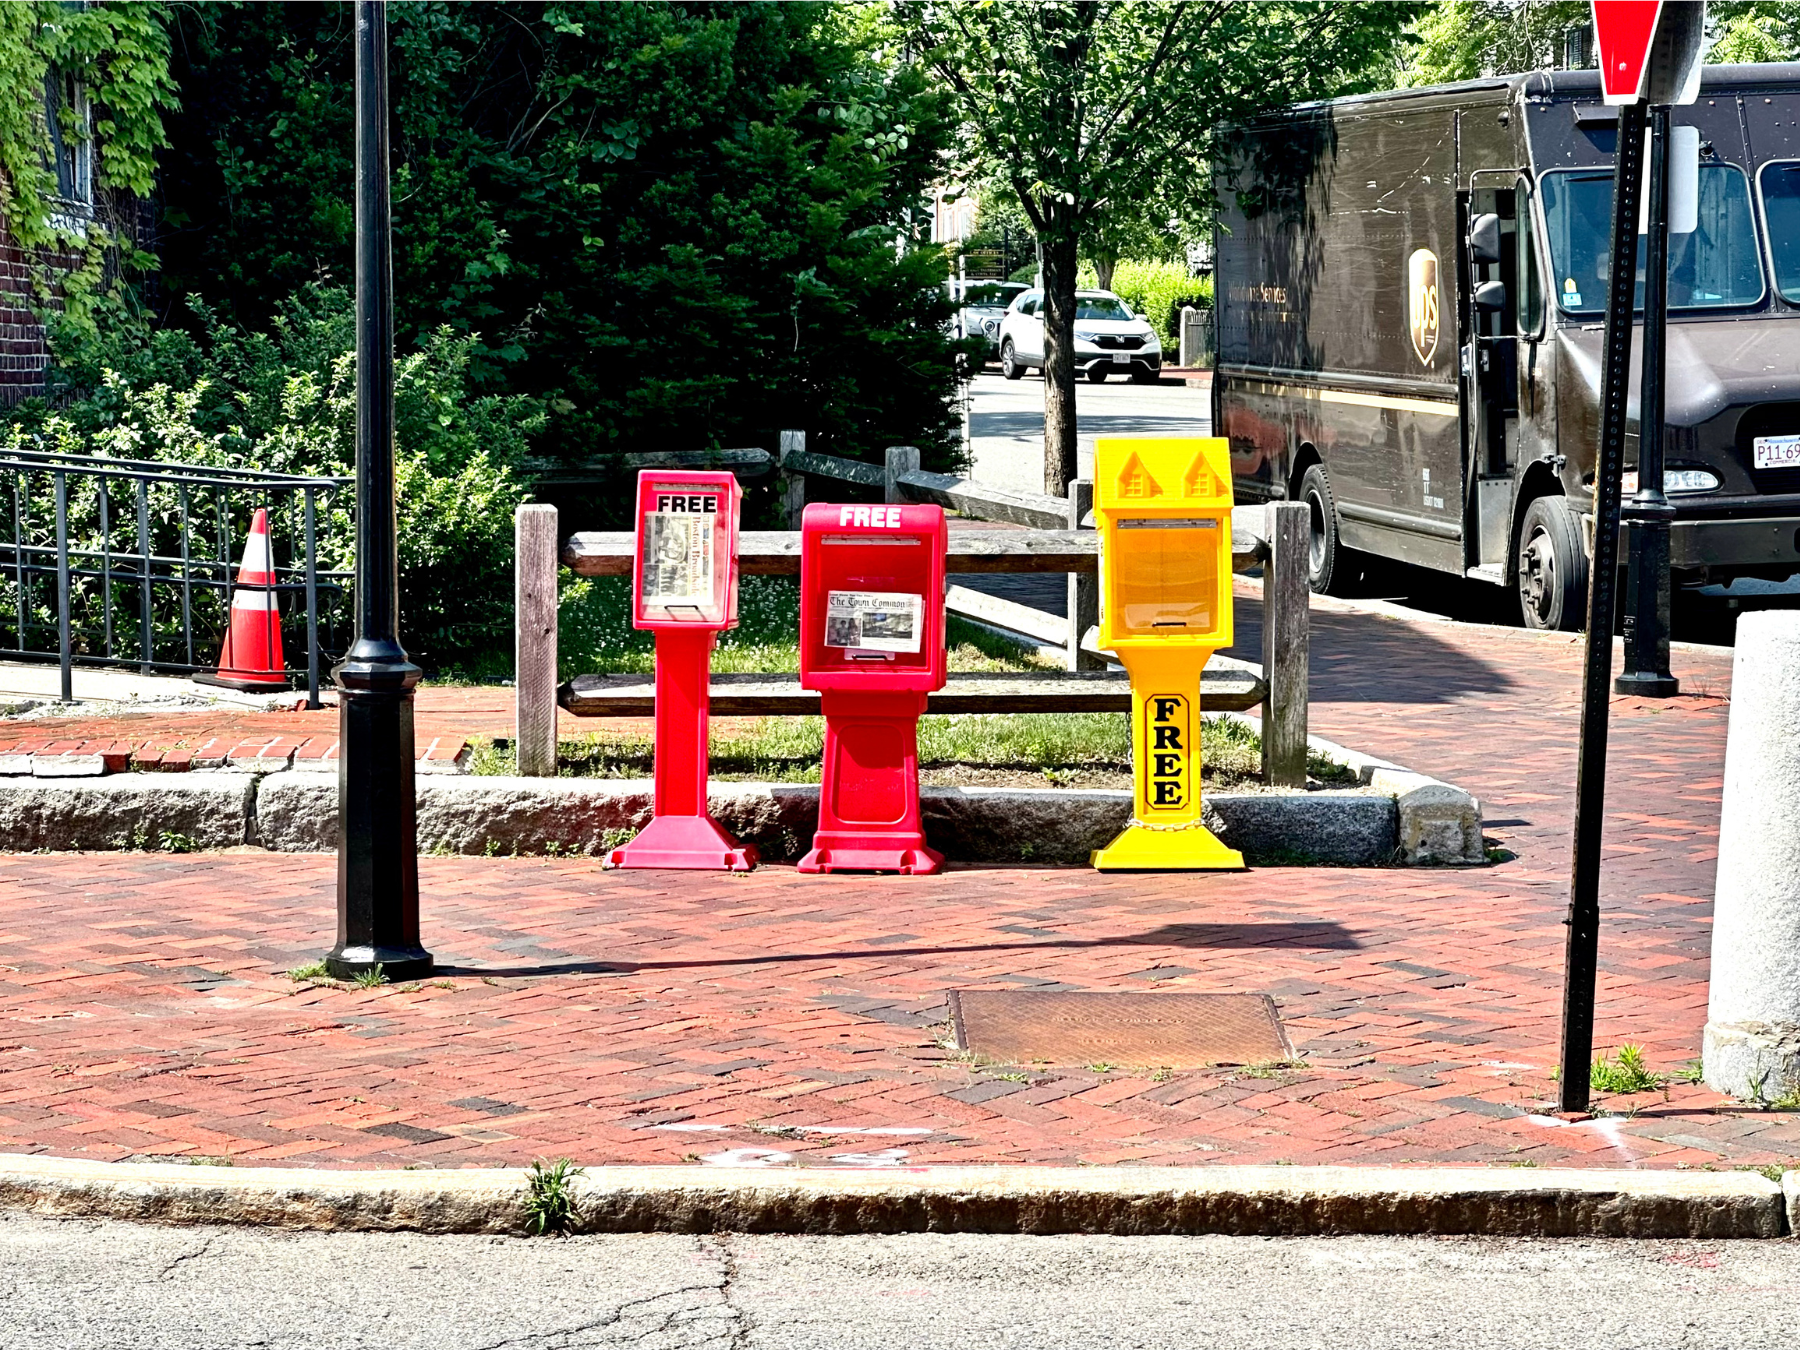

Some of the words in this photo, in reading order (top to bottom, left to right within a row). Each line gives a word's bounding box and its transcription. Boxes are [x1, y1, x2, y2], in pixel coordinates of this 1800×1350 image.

[1412, 284, 1437, 348] ups
[658, 496, 717, 513] FREE
[839, 506, 901, 528] FREE
[829, 596, 845, 606] The
[848, 597, 870, 607] Town
[1153, 698, 1183, 805] FREE
